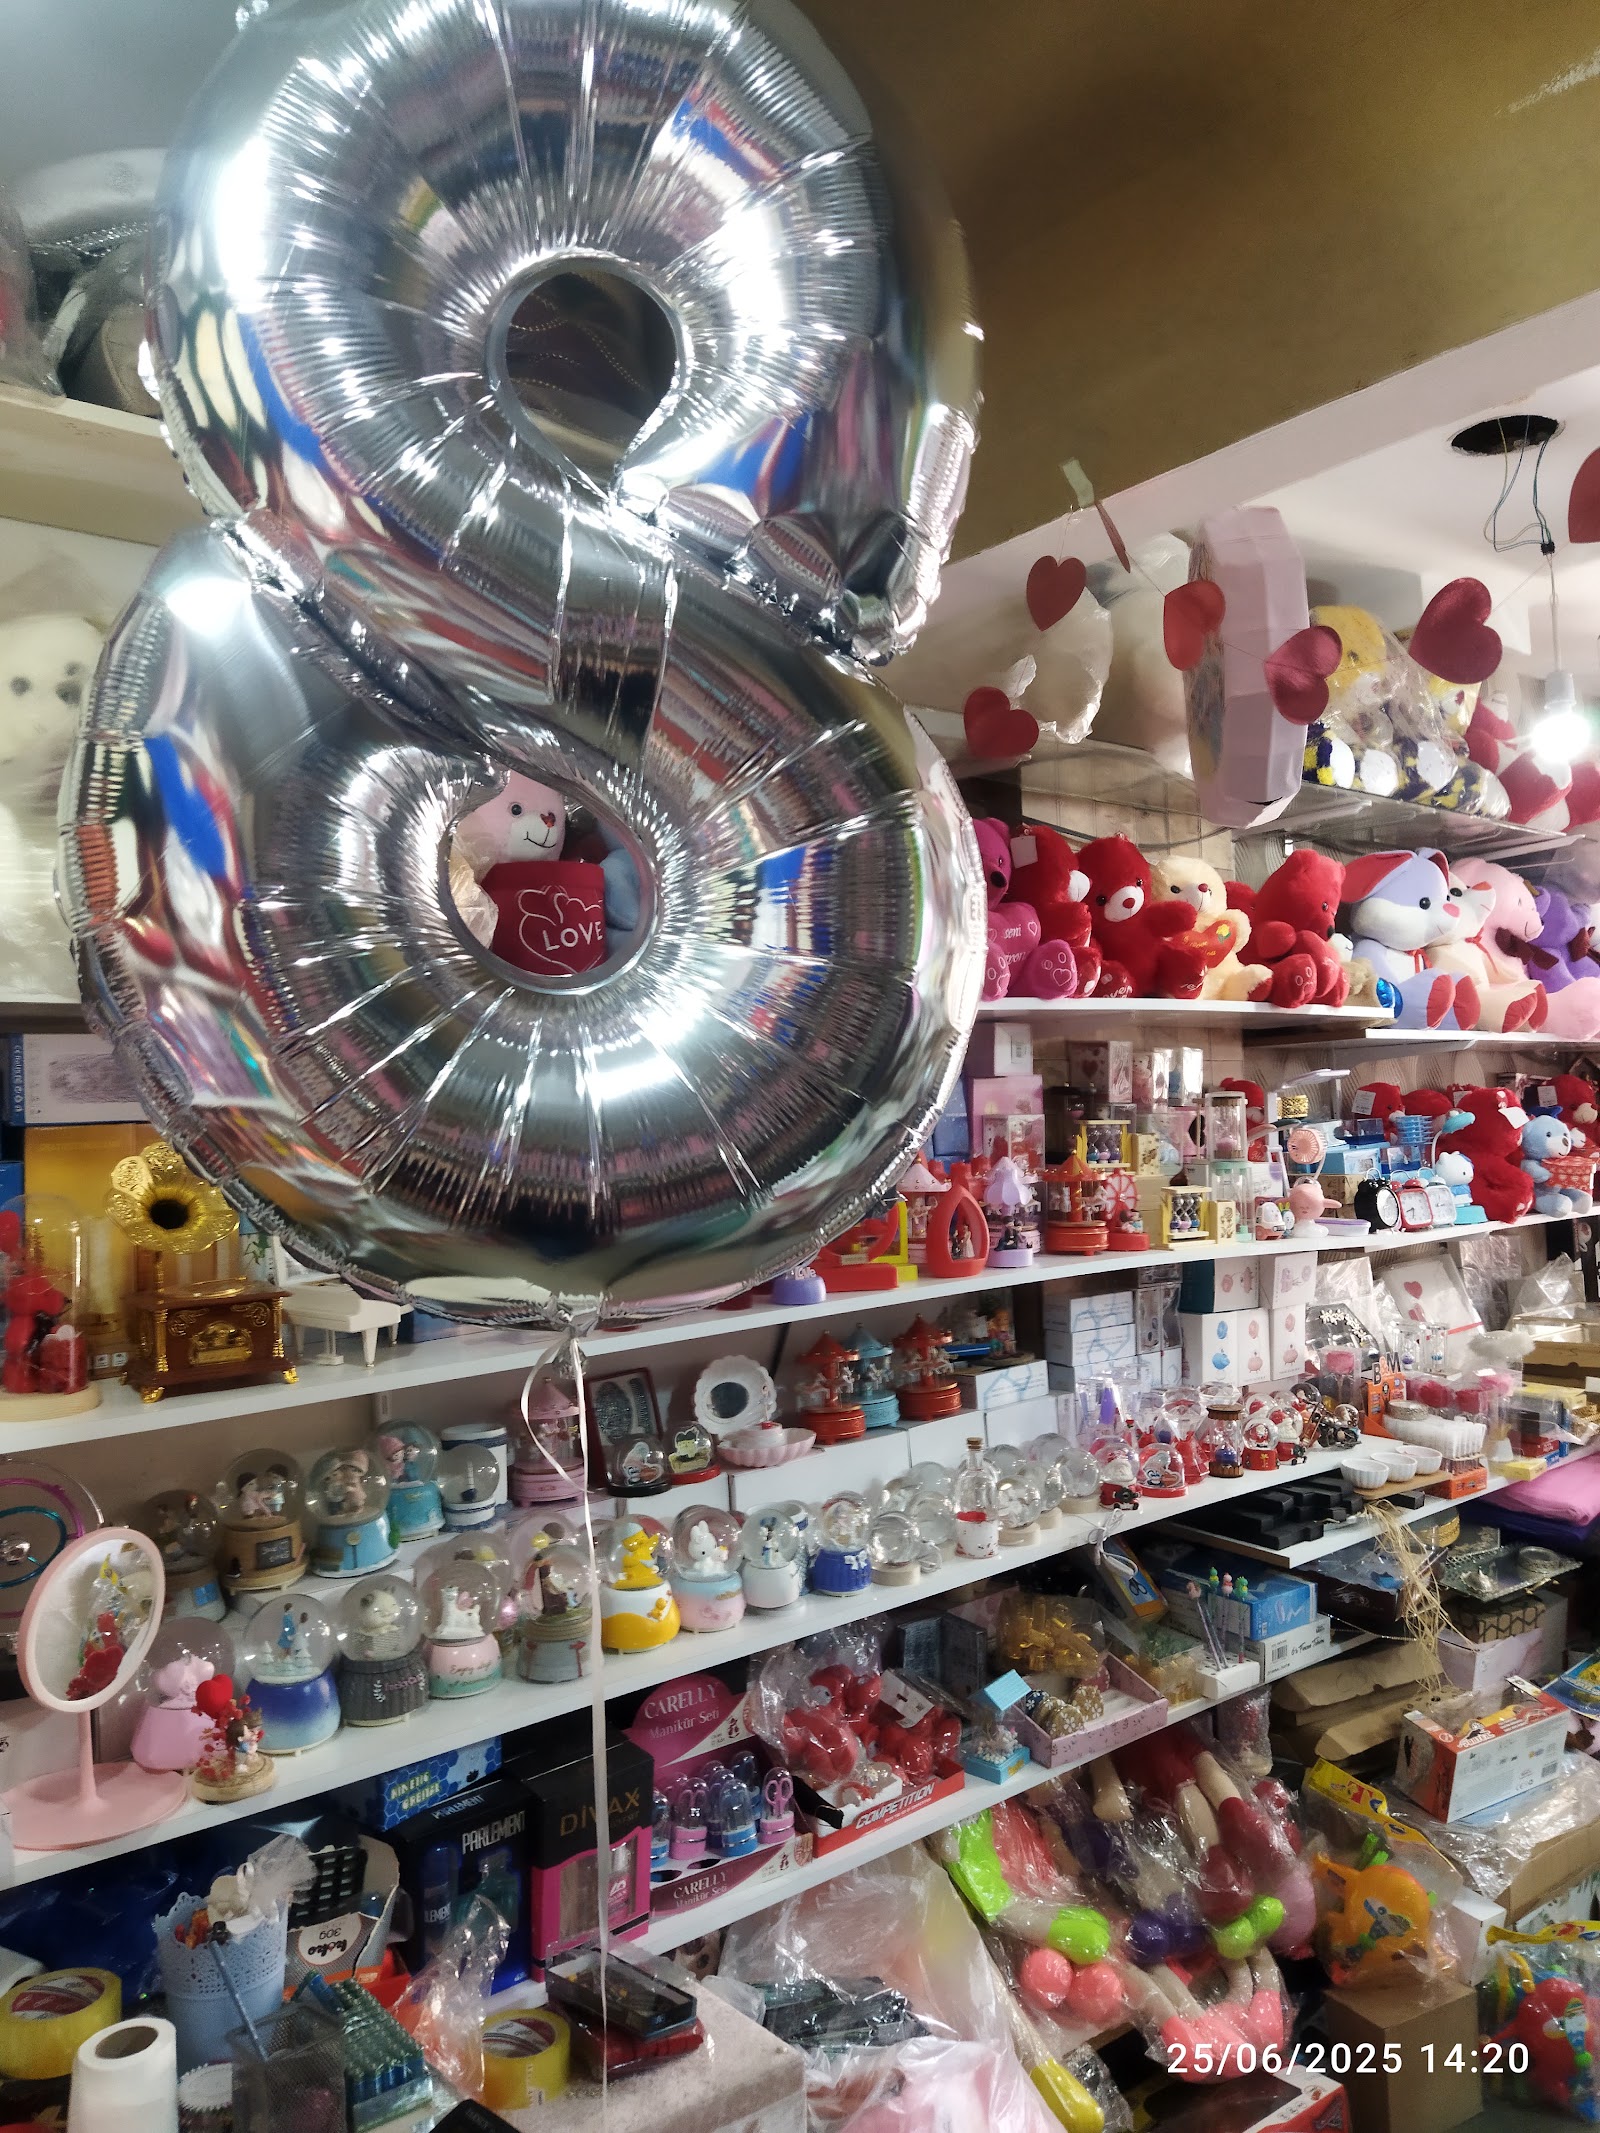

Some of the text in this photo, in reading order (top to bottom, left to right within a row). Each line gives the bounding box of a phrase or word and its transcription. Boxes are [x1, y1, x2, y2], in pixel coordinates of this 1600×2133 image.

[542, 920, 604, 951] LOVE
[644, 1682, 720, 1719] CARELLY
[649, 1708, 720, 1739] Manikür Seti
[855, 1782, 936, 1830] COMPETITION
[462, 1810, 526, 1855] PARLEMENT
[673, 1870, 727, 1899] CARELLY
